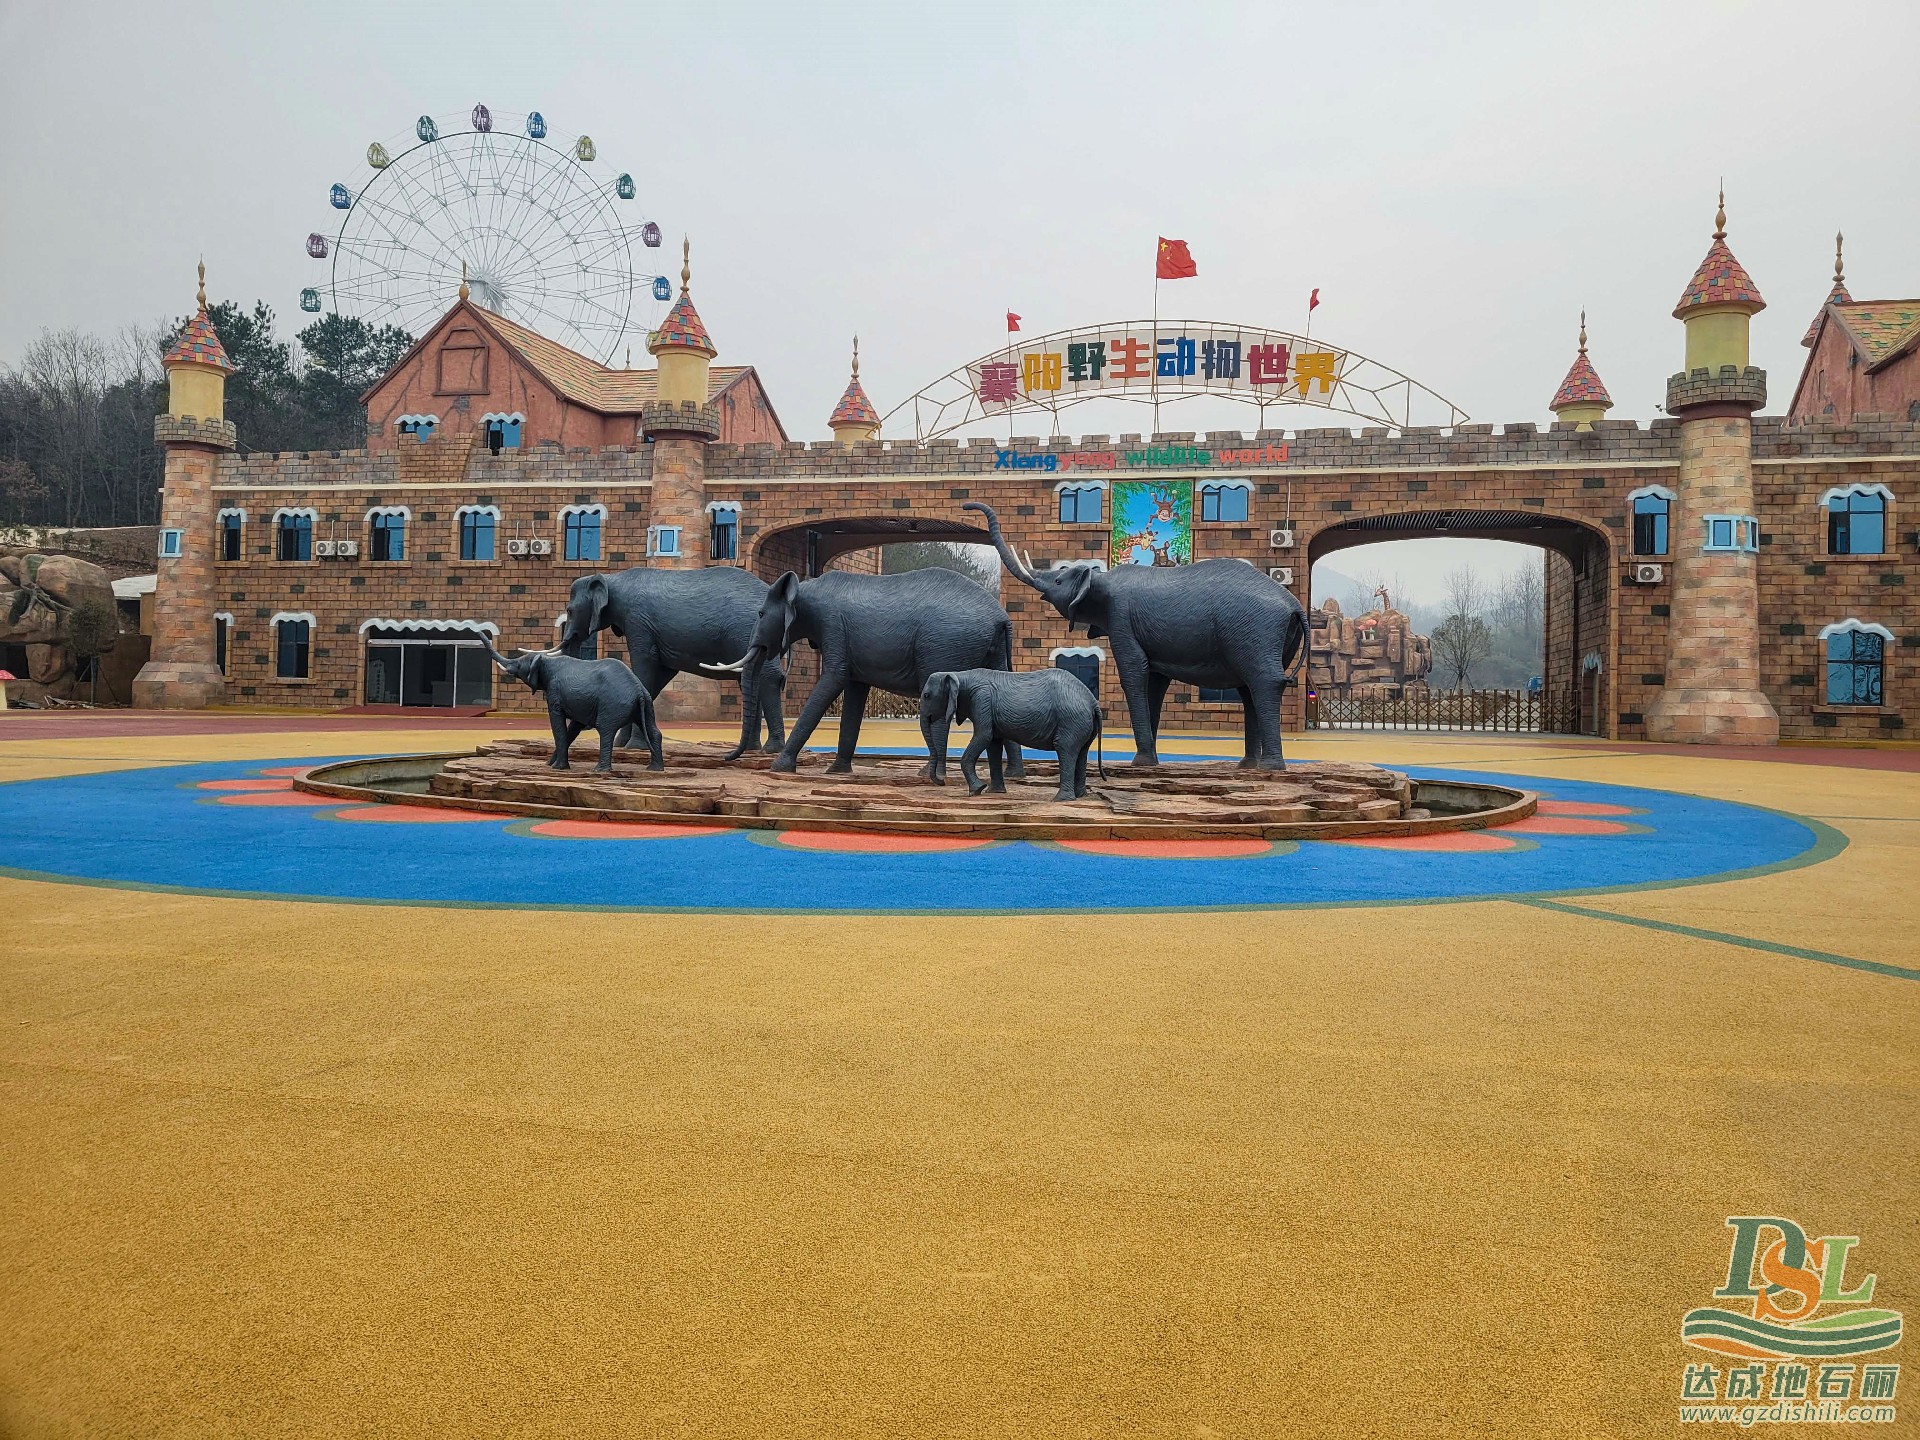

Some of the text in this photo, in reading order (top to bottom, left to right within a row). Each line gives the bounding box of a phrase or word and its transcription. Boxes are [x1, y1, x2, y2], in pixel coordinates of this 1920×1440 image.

[979, 335, 1336, 403] 襄阳野生动物世界
[1126, 446, 1211, 465] wildlife
[1219, 443, 1289, 463] world
